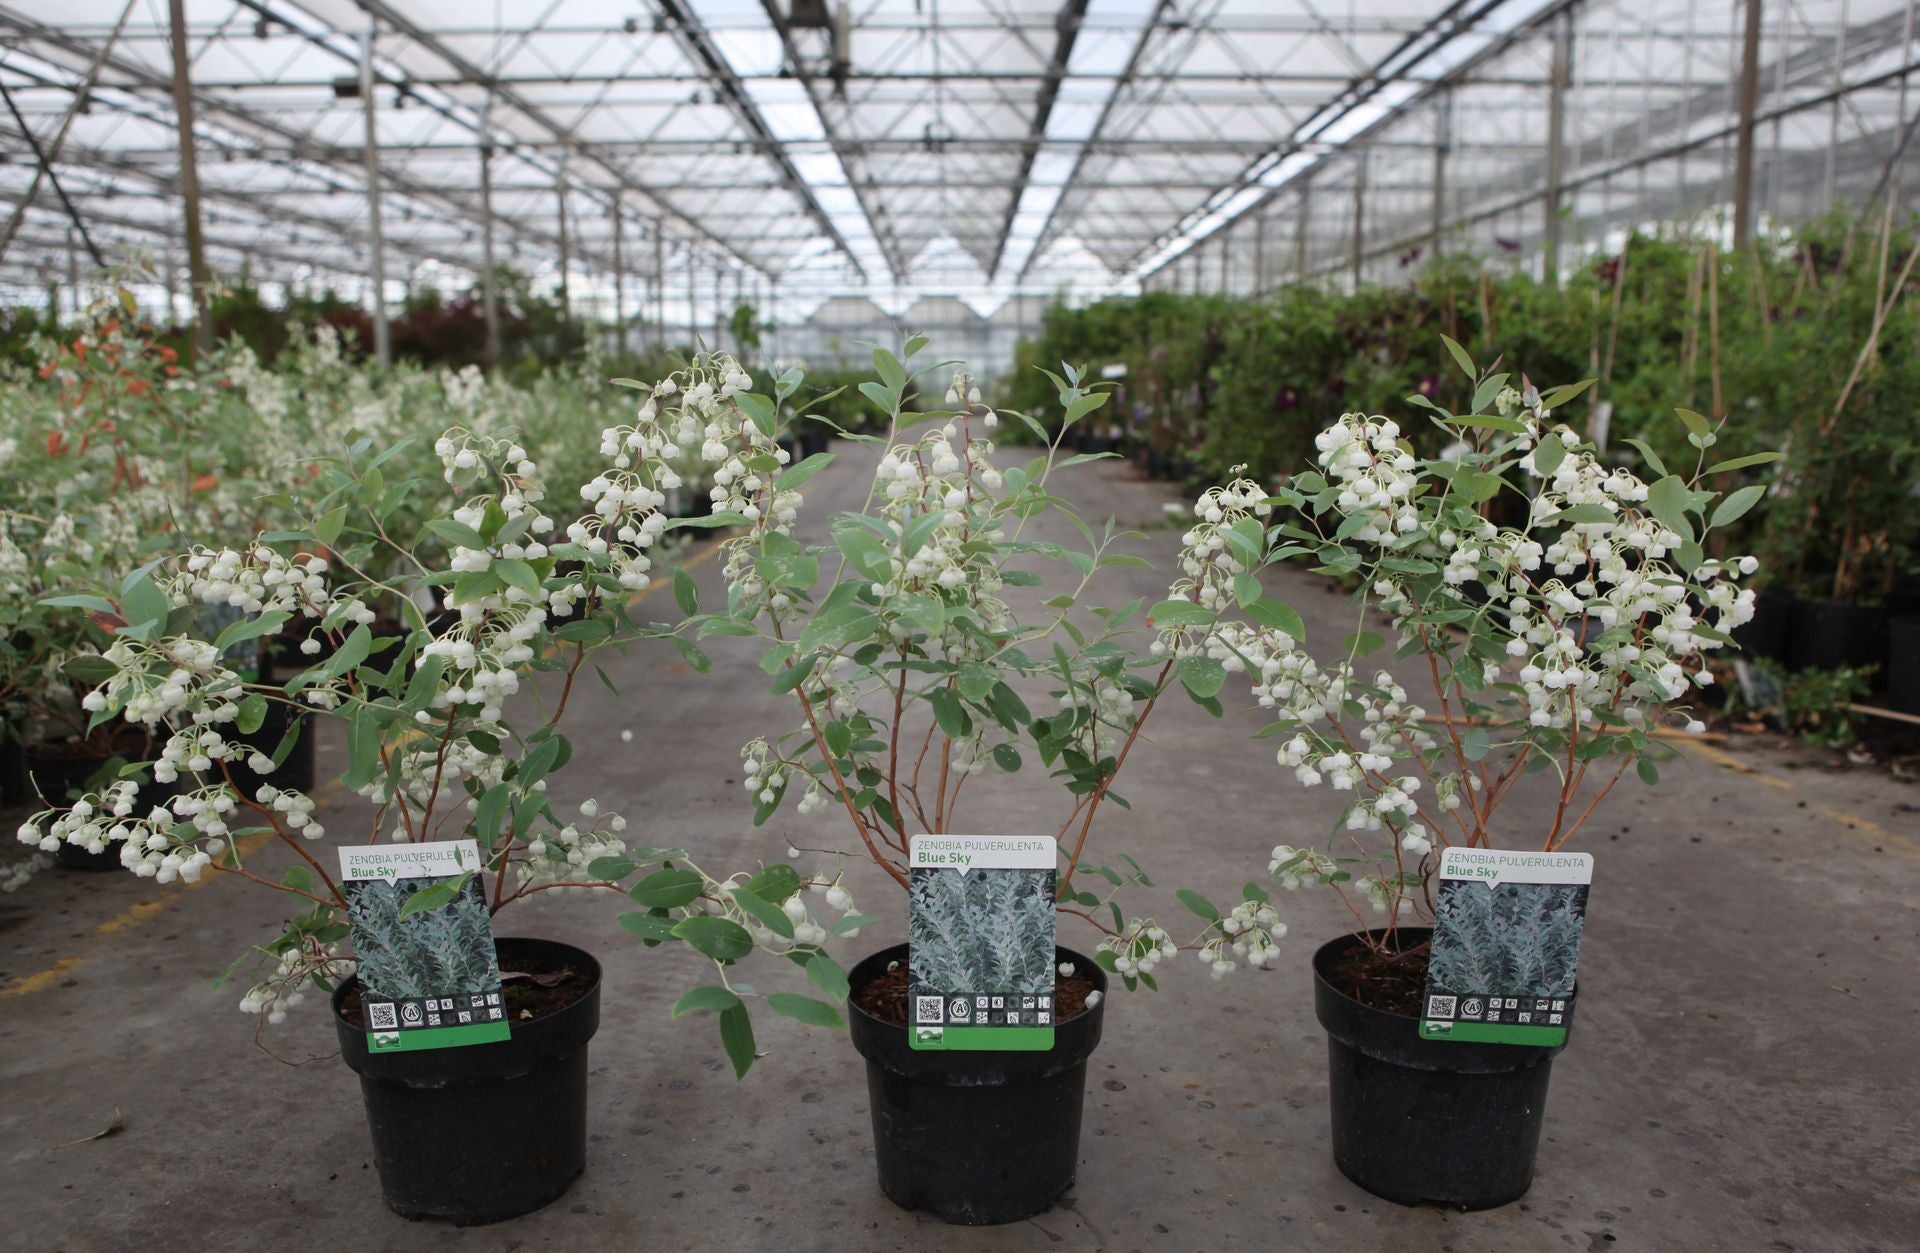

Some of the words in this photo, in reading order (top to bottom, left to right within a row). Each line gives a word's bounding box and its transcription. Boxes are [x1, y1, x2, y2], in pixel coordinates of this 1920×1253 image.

[918, 841, 961, 850] ZENOBIA
[965, 841, 1044, 851] PULVERULENTA
[349, 854, 392, 865] ZENOBIA
[394, 849, 475, 863] PULVERULETA
[918, 852, 945, 863] Blue
[949, 852, 972, 865] Sky
[1447, 853, 1496, 865] ZENOBIA
[1499, 856, 1585, 868] PULVERULENTA
[351, 867, 375, 878] Blue
[377, 866, 397, 878] Sky
[1446, 865, 1474, 875] Blue
[1476, 866, 1498, 880] Sky
